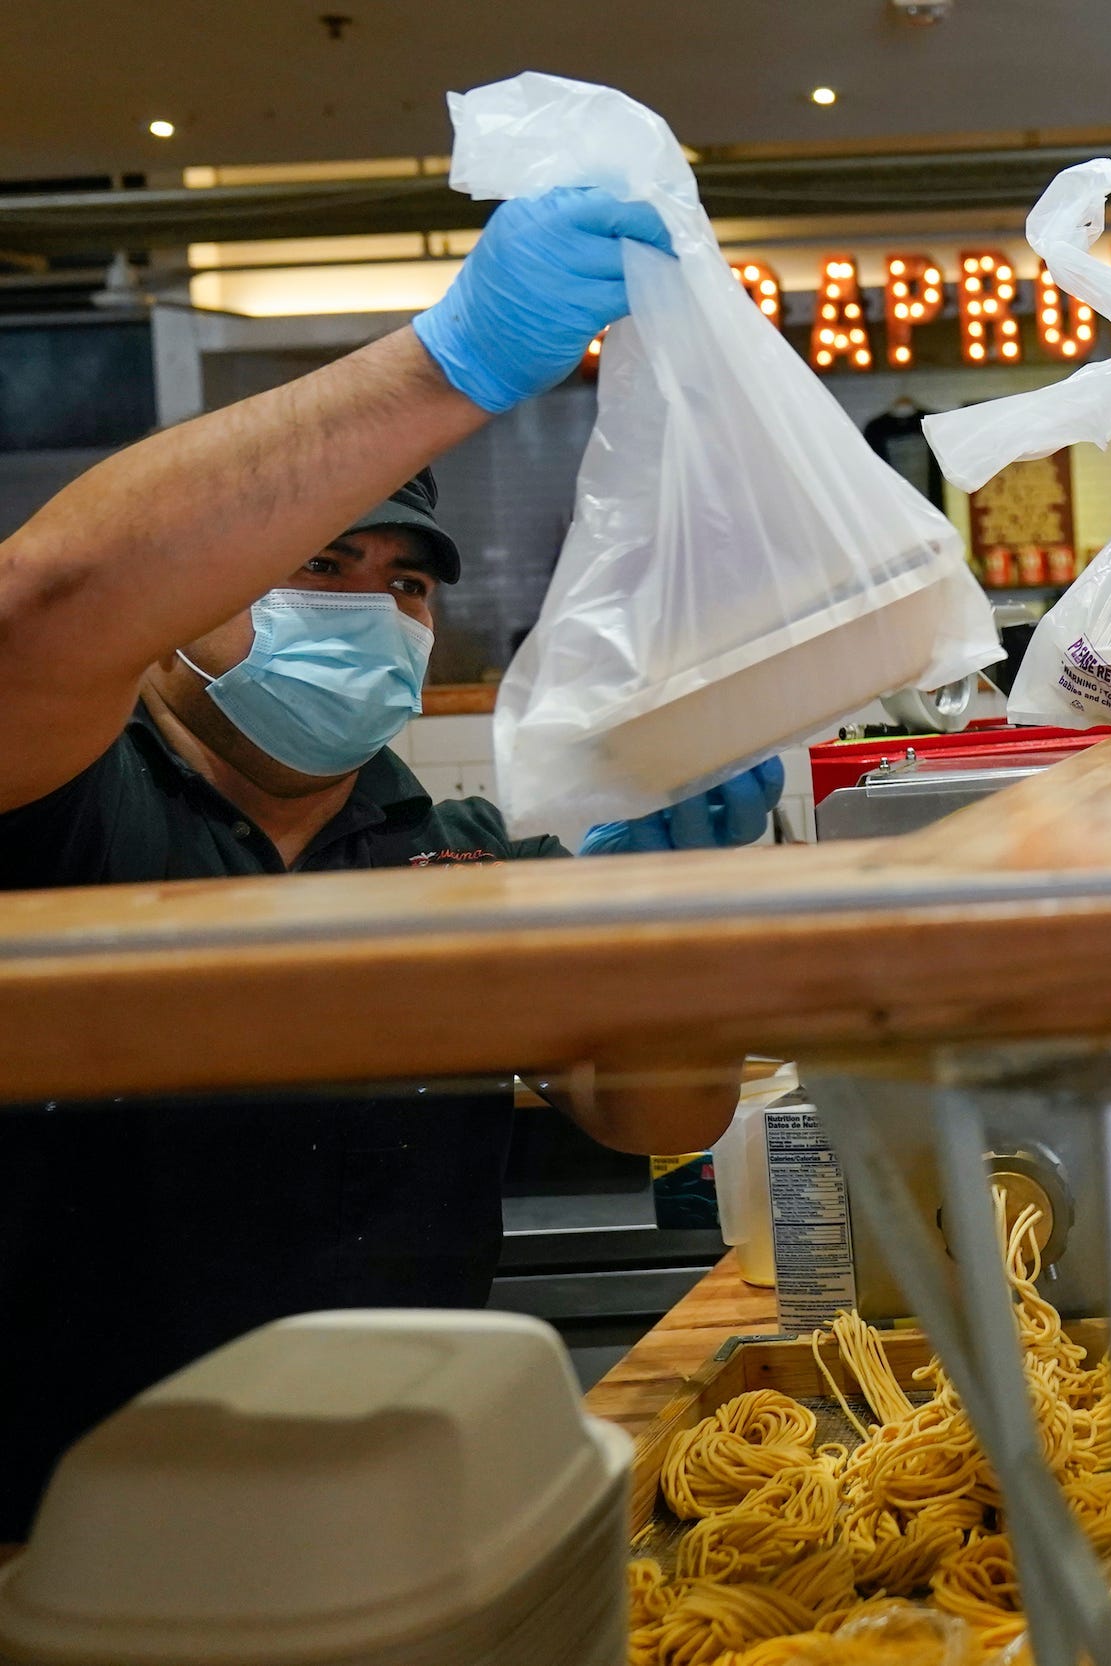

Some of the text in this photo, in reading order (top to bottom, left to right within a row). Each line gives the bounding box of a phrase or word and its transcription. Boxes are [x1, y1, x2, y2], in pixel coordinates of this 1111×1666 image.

[1067, 637, 1098, 674] PLEASE
[1058, 675, 1082, 696] babies
[1084, 692, 1100, 703] and
[767, 1114, 801, 1122] Nutrition
